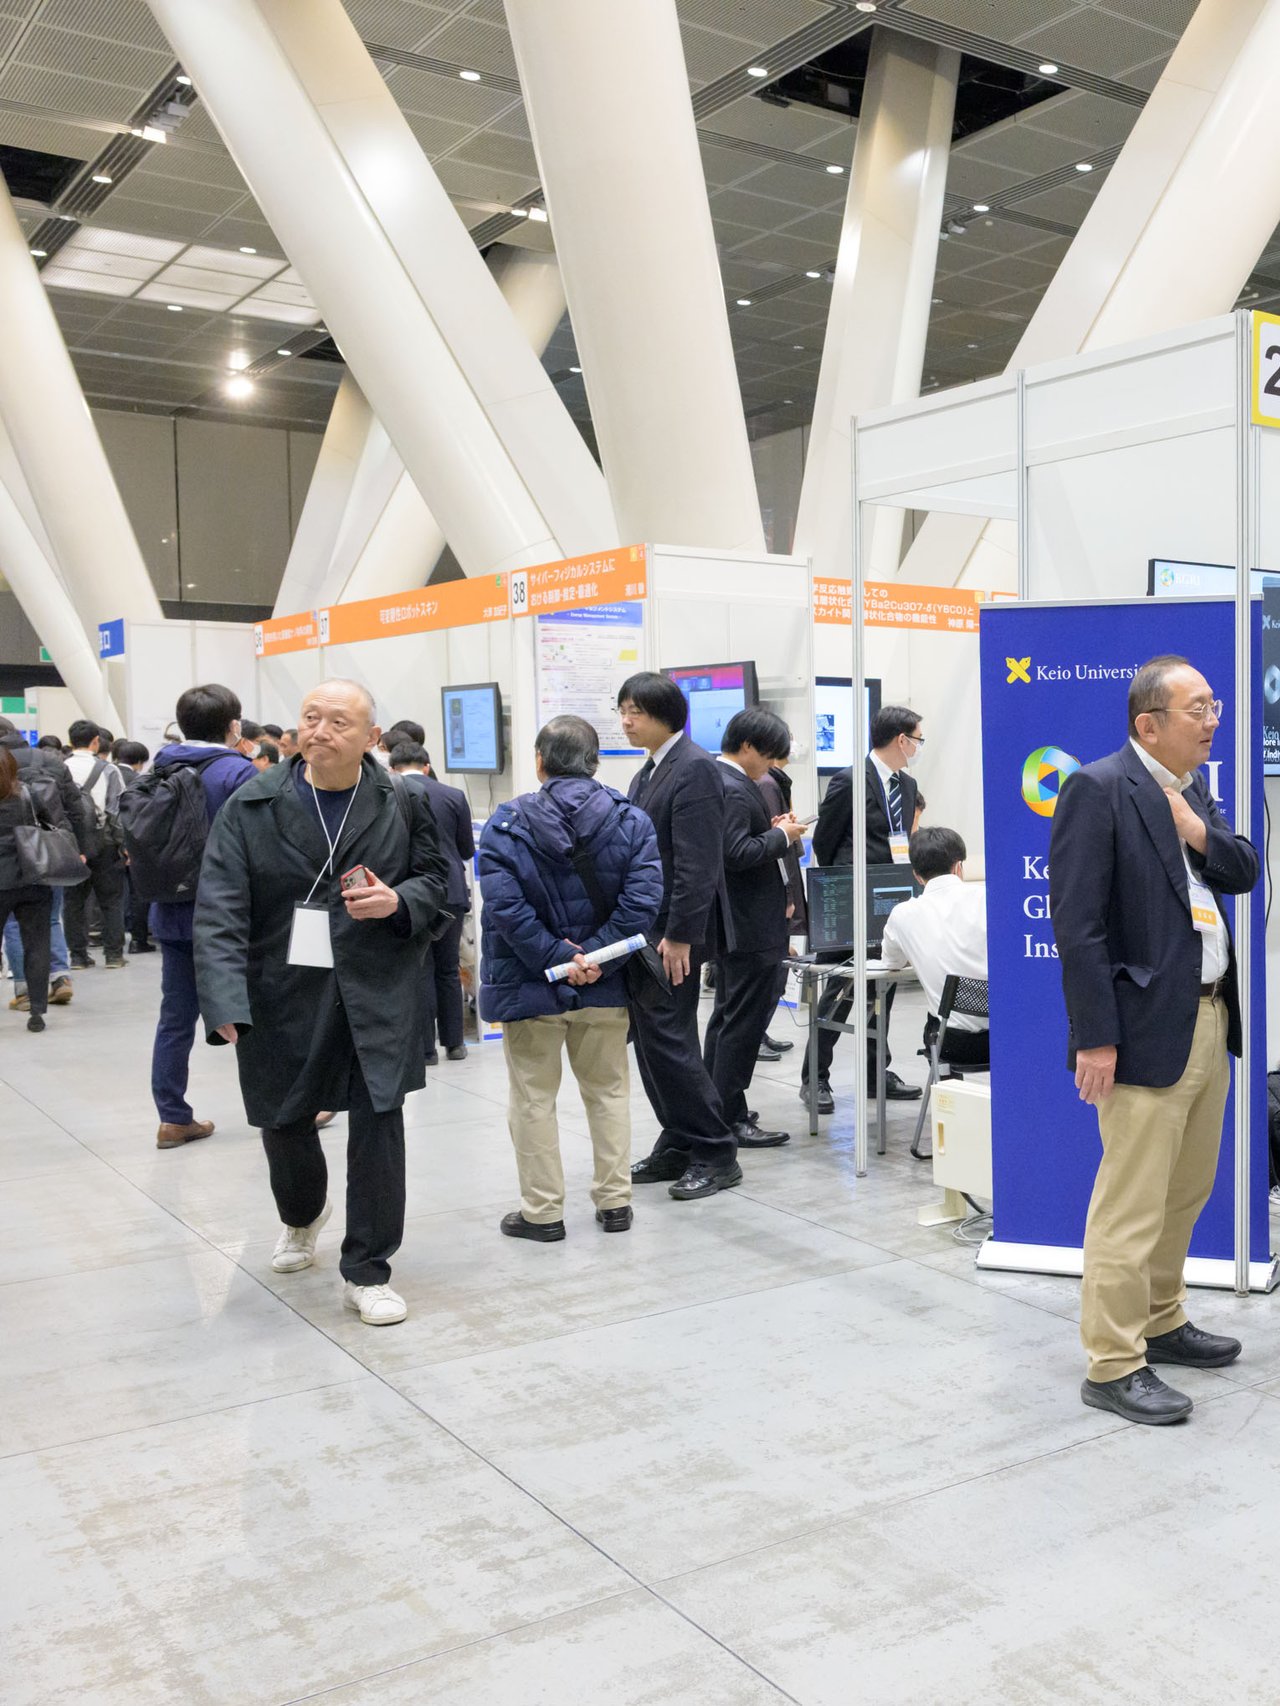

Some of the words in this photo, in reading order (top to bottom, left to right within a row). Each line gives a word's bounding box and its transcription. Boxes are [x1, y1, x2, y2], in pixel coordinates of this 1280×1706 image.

[513, 582, 525, 604] 38
[1037, 665, 1072, 681] Keio
[1075, 664, 1142, 681] Universi
